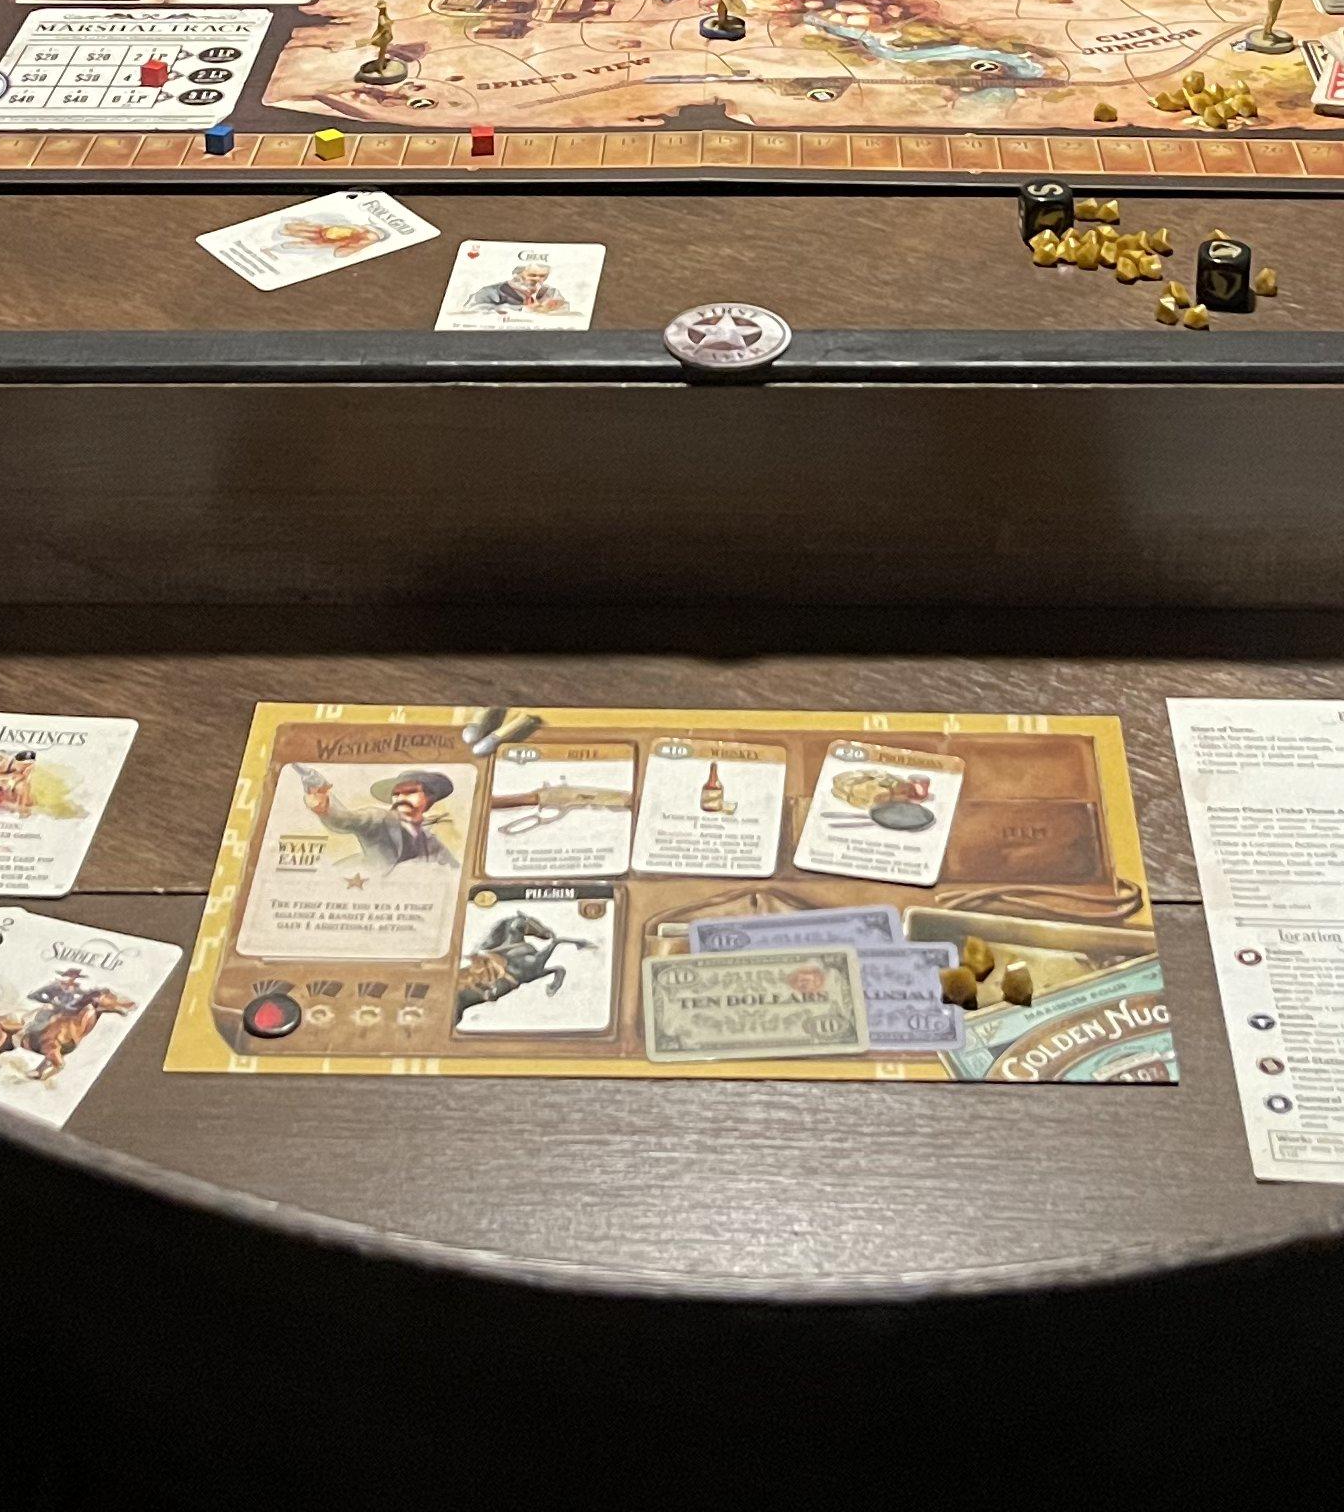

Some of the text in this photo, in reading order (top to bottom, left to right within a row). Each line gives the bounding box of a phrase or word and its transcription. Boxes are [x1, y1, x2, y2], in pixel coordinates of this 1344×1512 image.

[35, 24, 252, 33] MARSHAL TRACK
[1081, 28, 1203, 56] JUNCTION
[476, 57, 652, 91] SPIKE'S VIEW
[315, 738, 393, 761] WESTERN
[278, 840, 327, 854] WYATT
[278, 853, 321, 866] EARP
[680, 991, 830, 1009] TEN DOLLARS
[1001, 1019, 1107, 1081] GOLDEN
